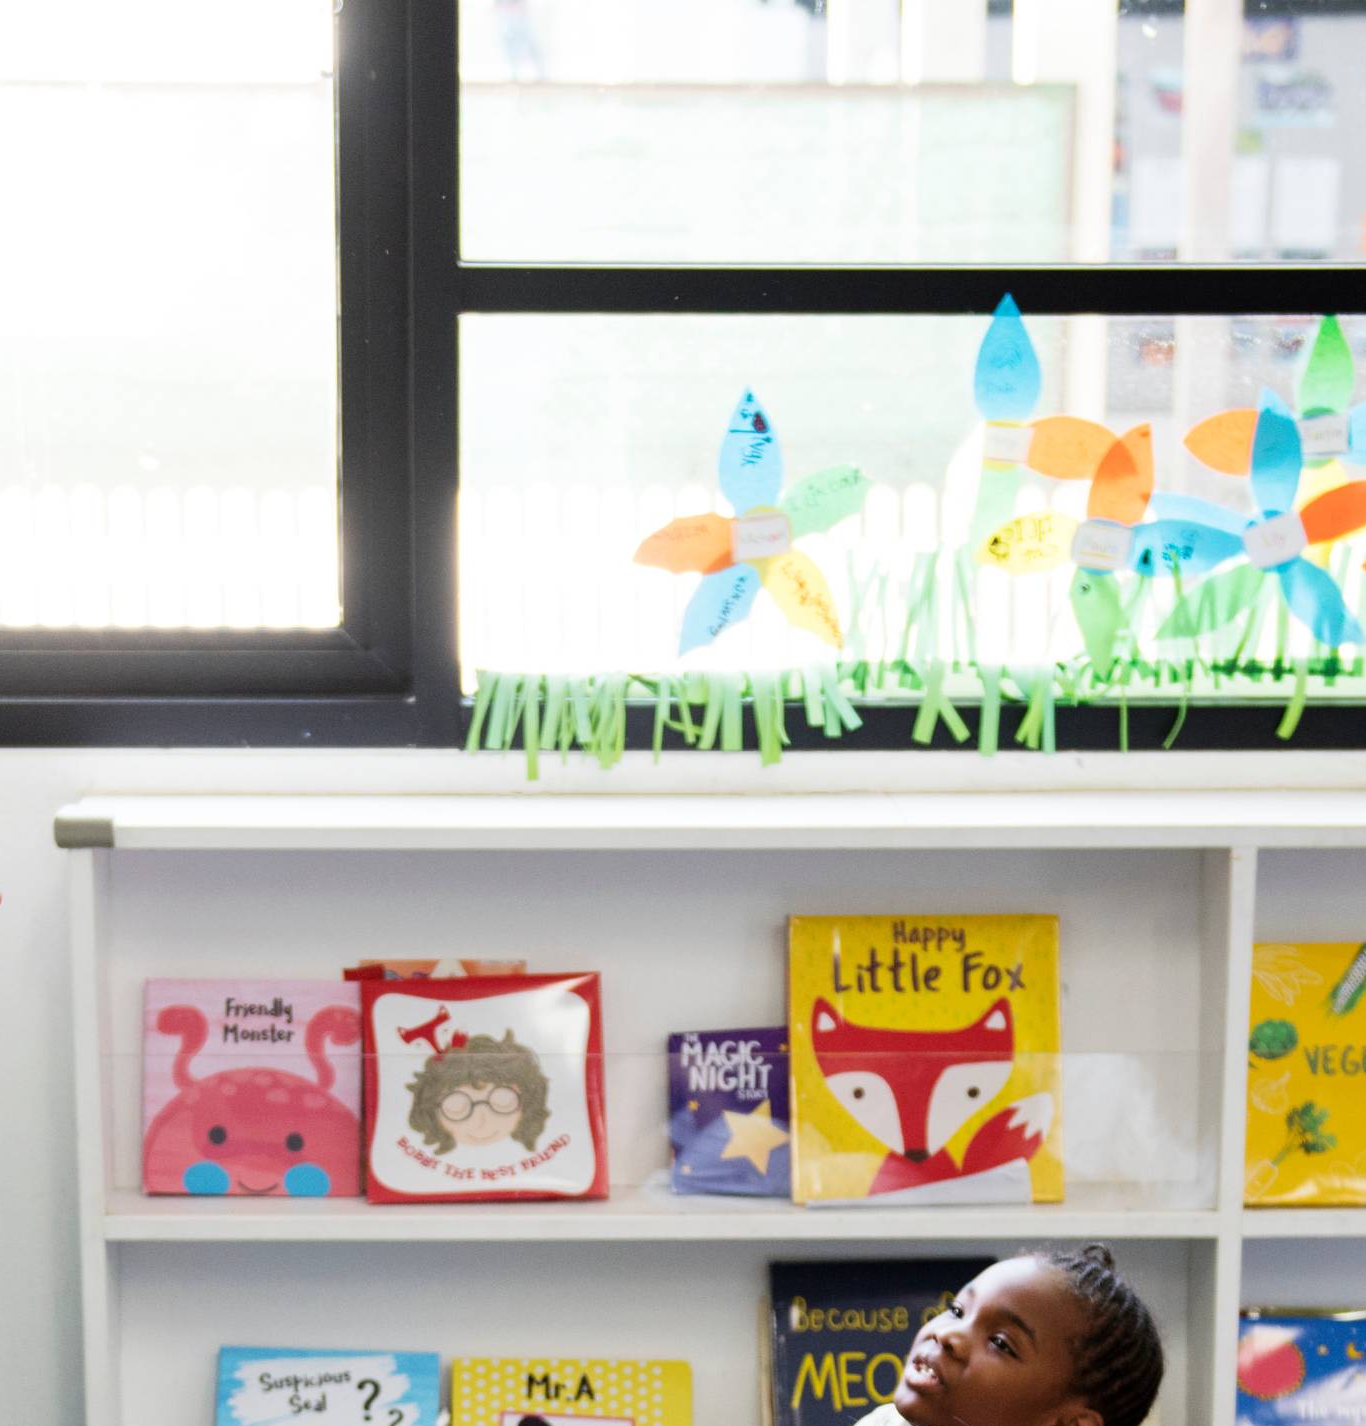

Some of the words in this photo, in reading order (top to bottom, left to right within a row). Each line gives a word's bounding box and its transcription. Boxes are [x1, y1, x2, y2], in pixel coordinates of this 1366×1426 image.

[892, 921, 966, 951] Happy
[833, 949, 941, 993] Little
[961, 952, 1026, 993] Fox
[225, 997, 293, 1023] Friendly
[223, 1022, 294, 1044] Monster
[680, 1040, 764, 1067] MAGIC
[689, 1063, 773, 1092] NIGHT
[791, 1295, 908, 1332] Because
[259, 1369, 352, 1393] Suspicious
[791, 1352, 907, 1412] MEO
[288, 1393, 327, 1414] Seal
